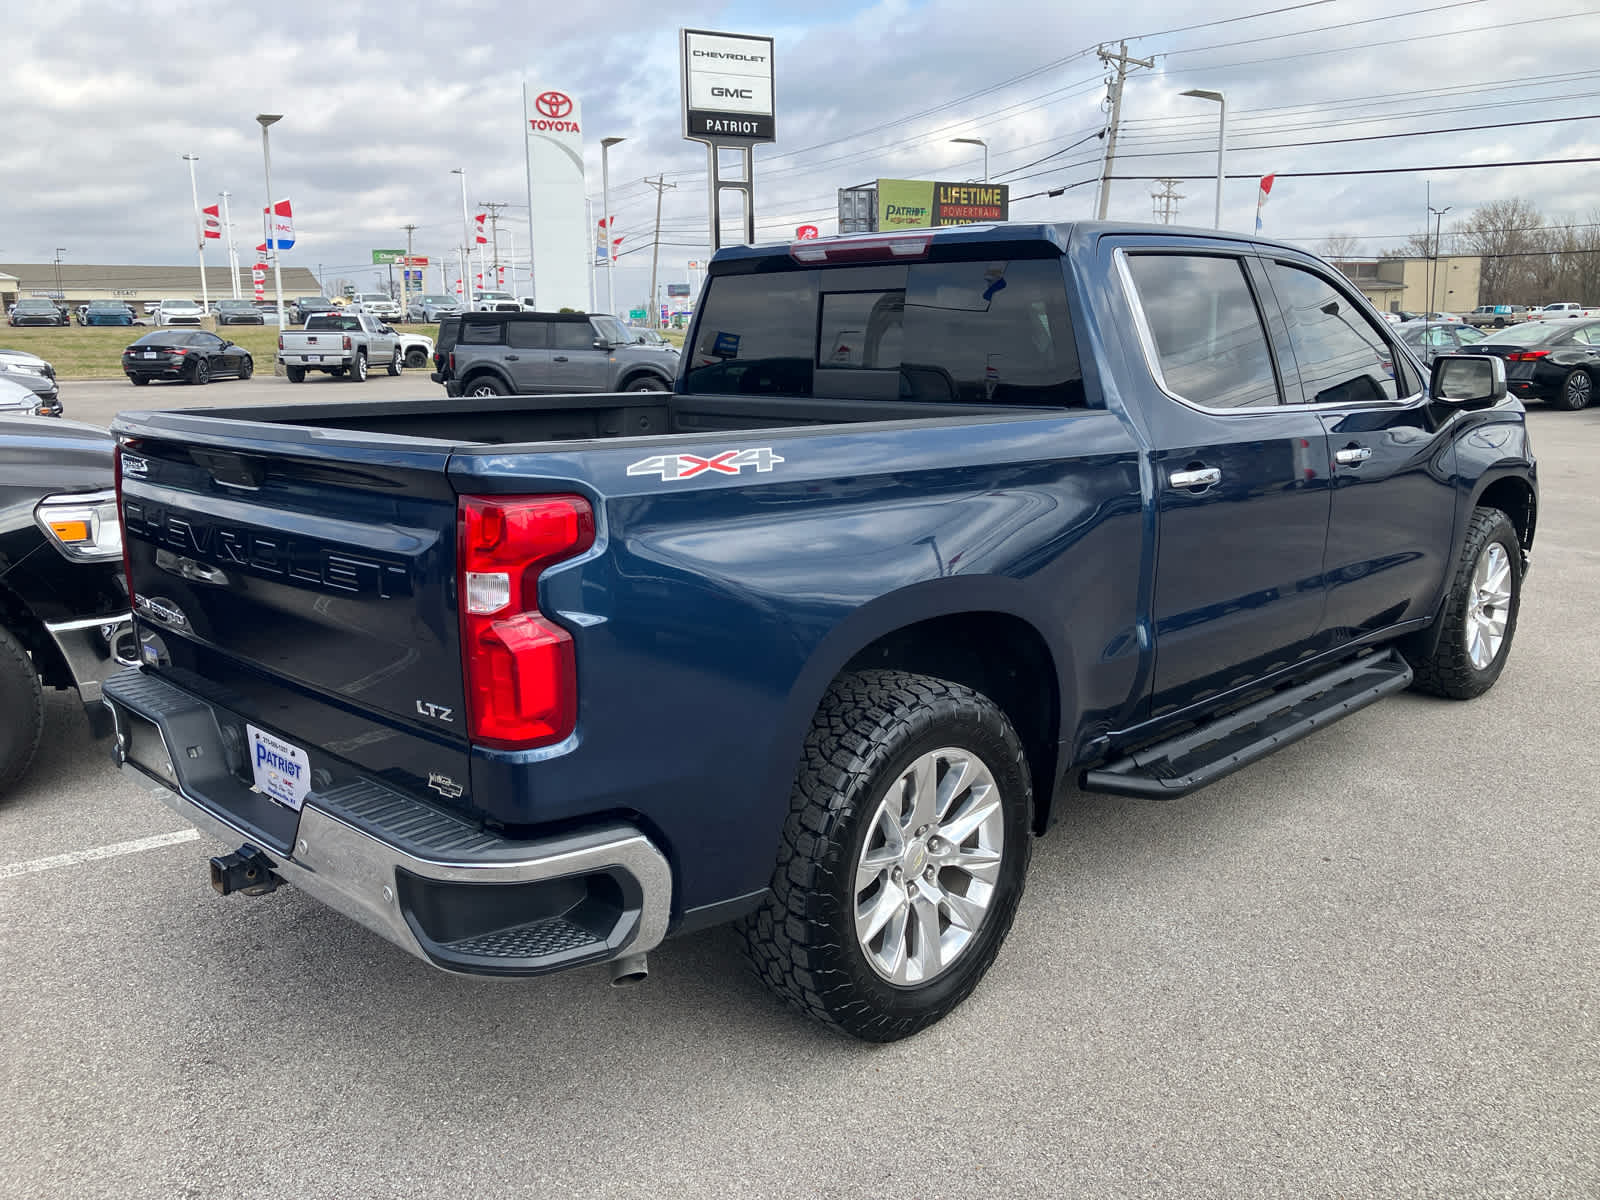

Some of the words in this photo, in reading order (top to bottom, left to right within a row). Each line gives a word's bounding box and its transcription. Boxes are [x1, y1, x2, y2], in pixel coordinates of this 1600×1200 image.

[693, 50, 766, 62] CHEVROLET
[711, 87, 752, 99] GMC
[529, 119, 580, 133] TOYOTA
[706, 119, 758, 134] PATRIOT
[940, 186, 1001, 205] LIFETIME
[885, 204, 925, 220] PATRIOT
[943, 206, 998, 217] POWERTRAIN
[124, 502, 408, 599] CHEVROLET
[415, 700, 453, 722] LTZ
[256, 742, 302, 779] PATRIOT
